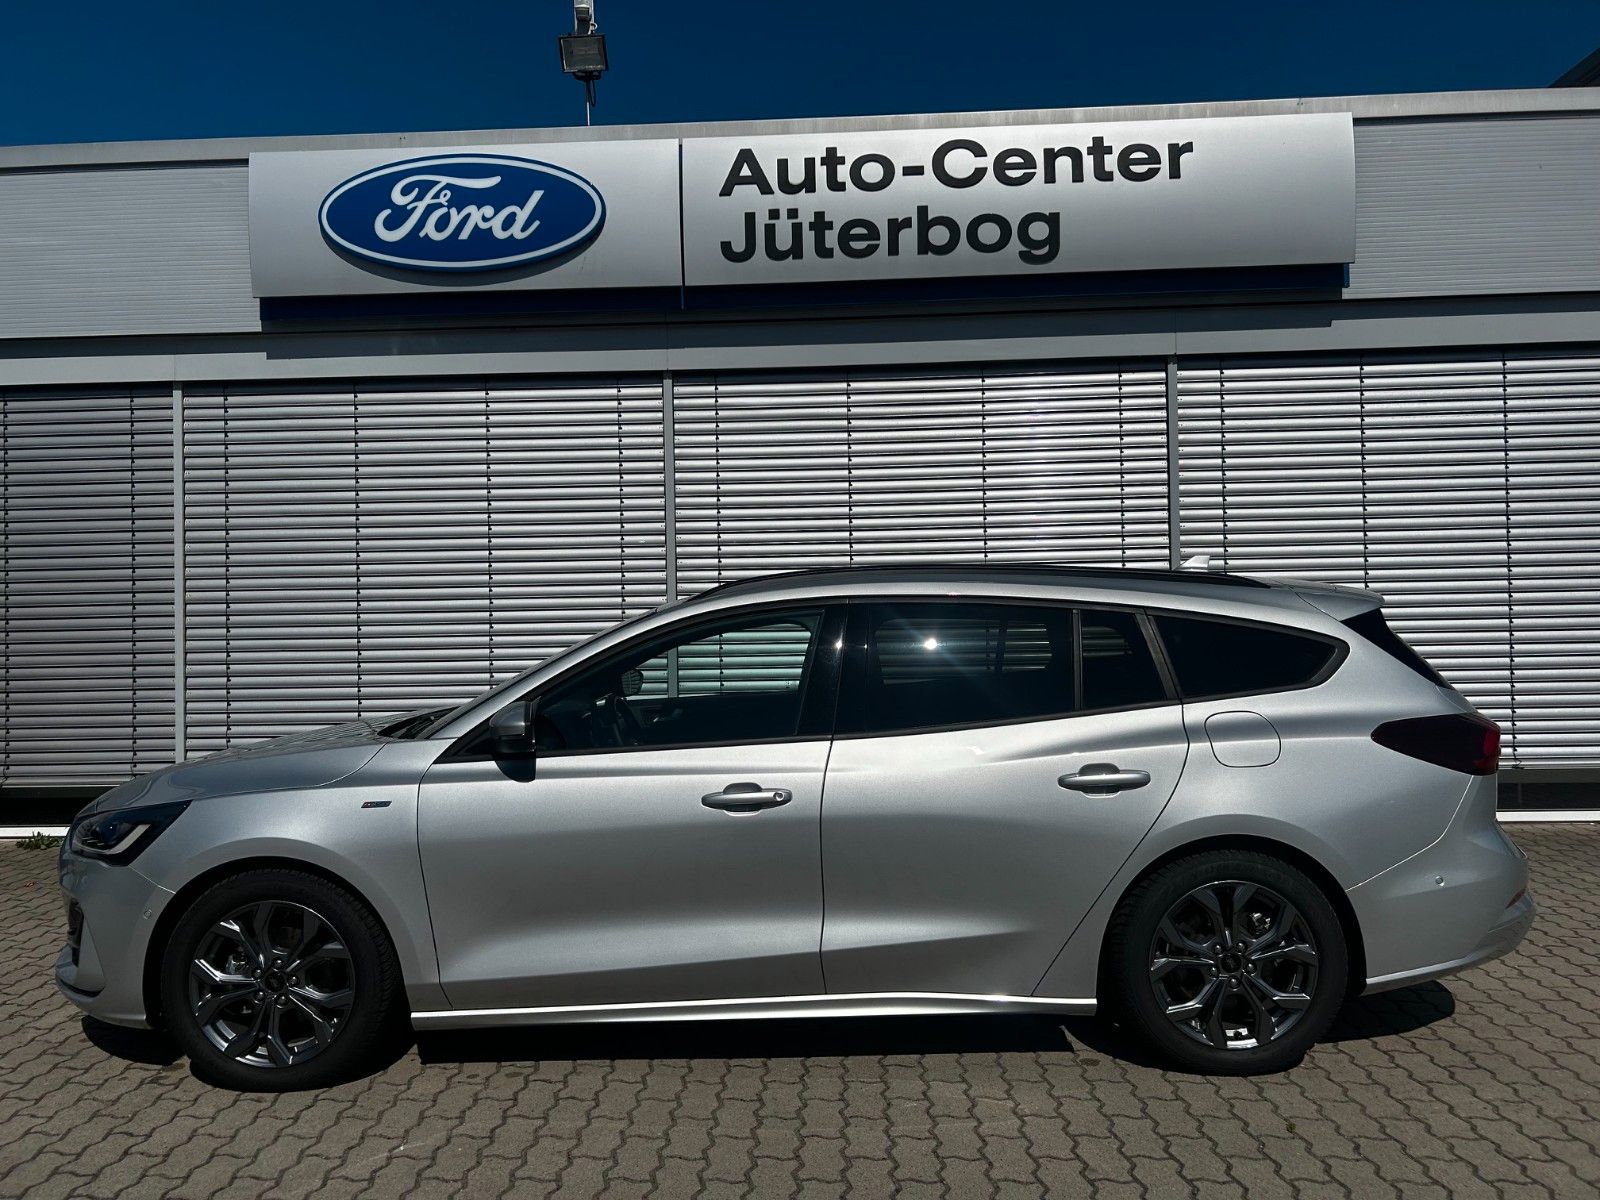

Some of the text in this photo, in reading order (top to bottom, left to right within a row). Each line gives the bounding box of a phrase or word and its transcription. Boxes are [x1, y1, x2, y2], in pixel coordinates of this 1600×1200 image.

[719, 136, 1194, 198] Auto-Center
[374, 174, 544, 242] Ford
[719, 205, 1061, 266] Jüterbog
